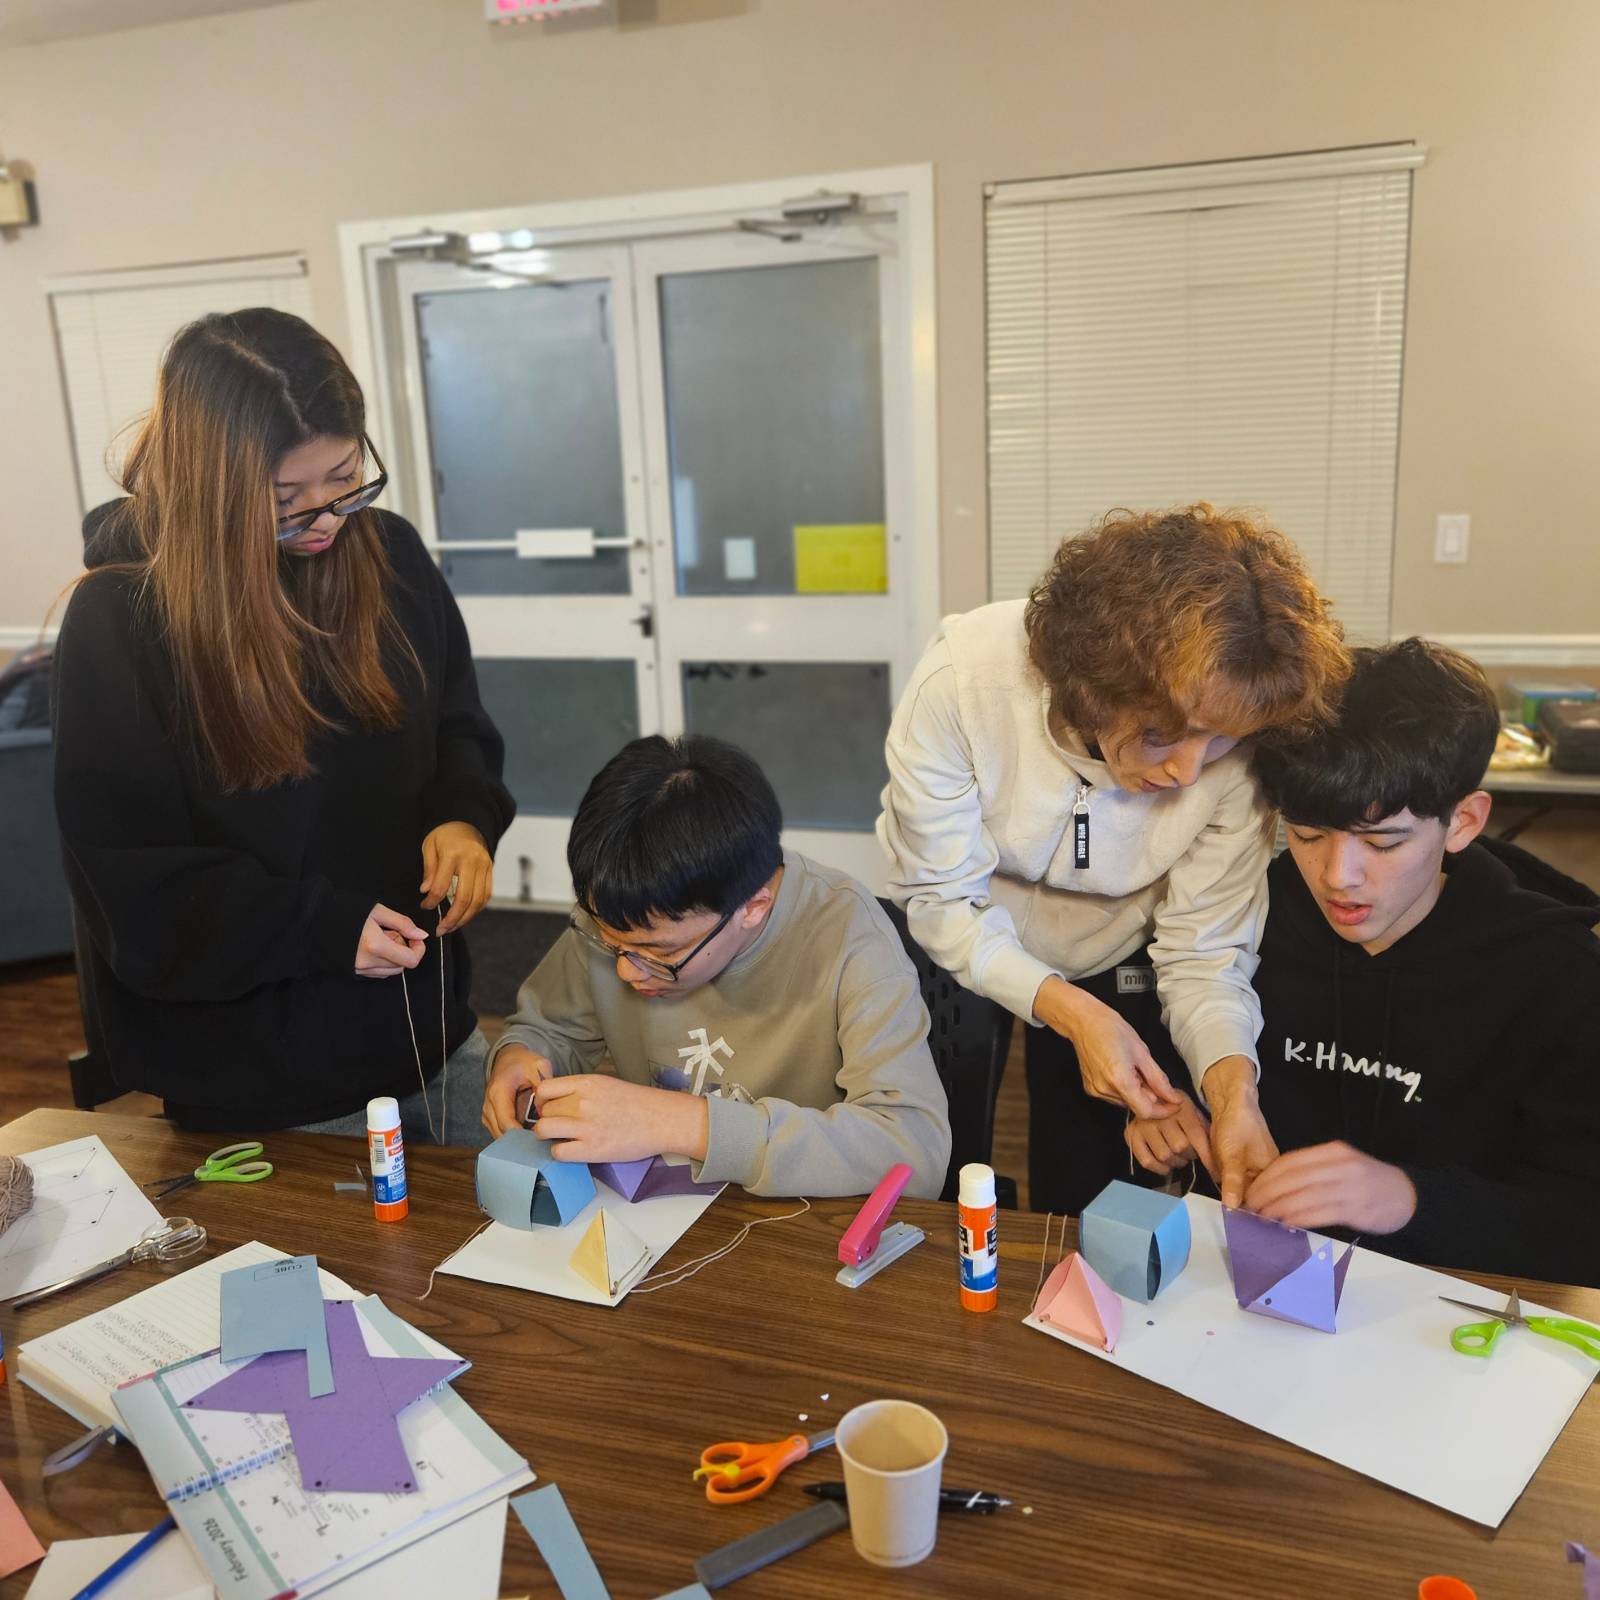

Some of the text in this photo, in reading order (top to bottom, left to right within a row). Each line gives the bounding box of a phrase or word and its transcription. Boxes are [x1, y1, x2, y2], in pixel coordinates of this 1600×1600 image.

[274, 1264, 303, 1273] CUBE
[204, 1517, 248, 1581] February 2026
